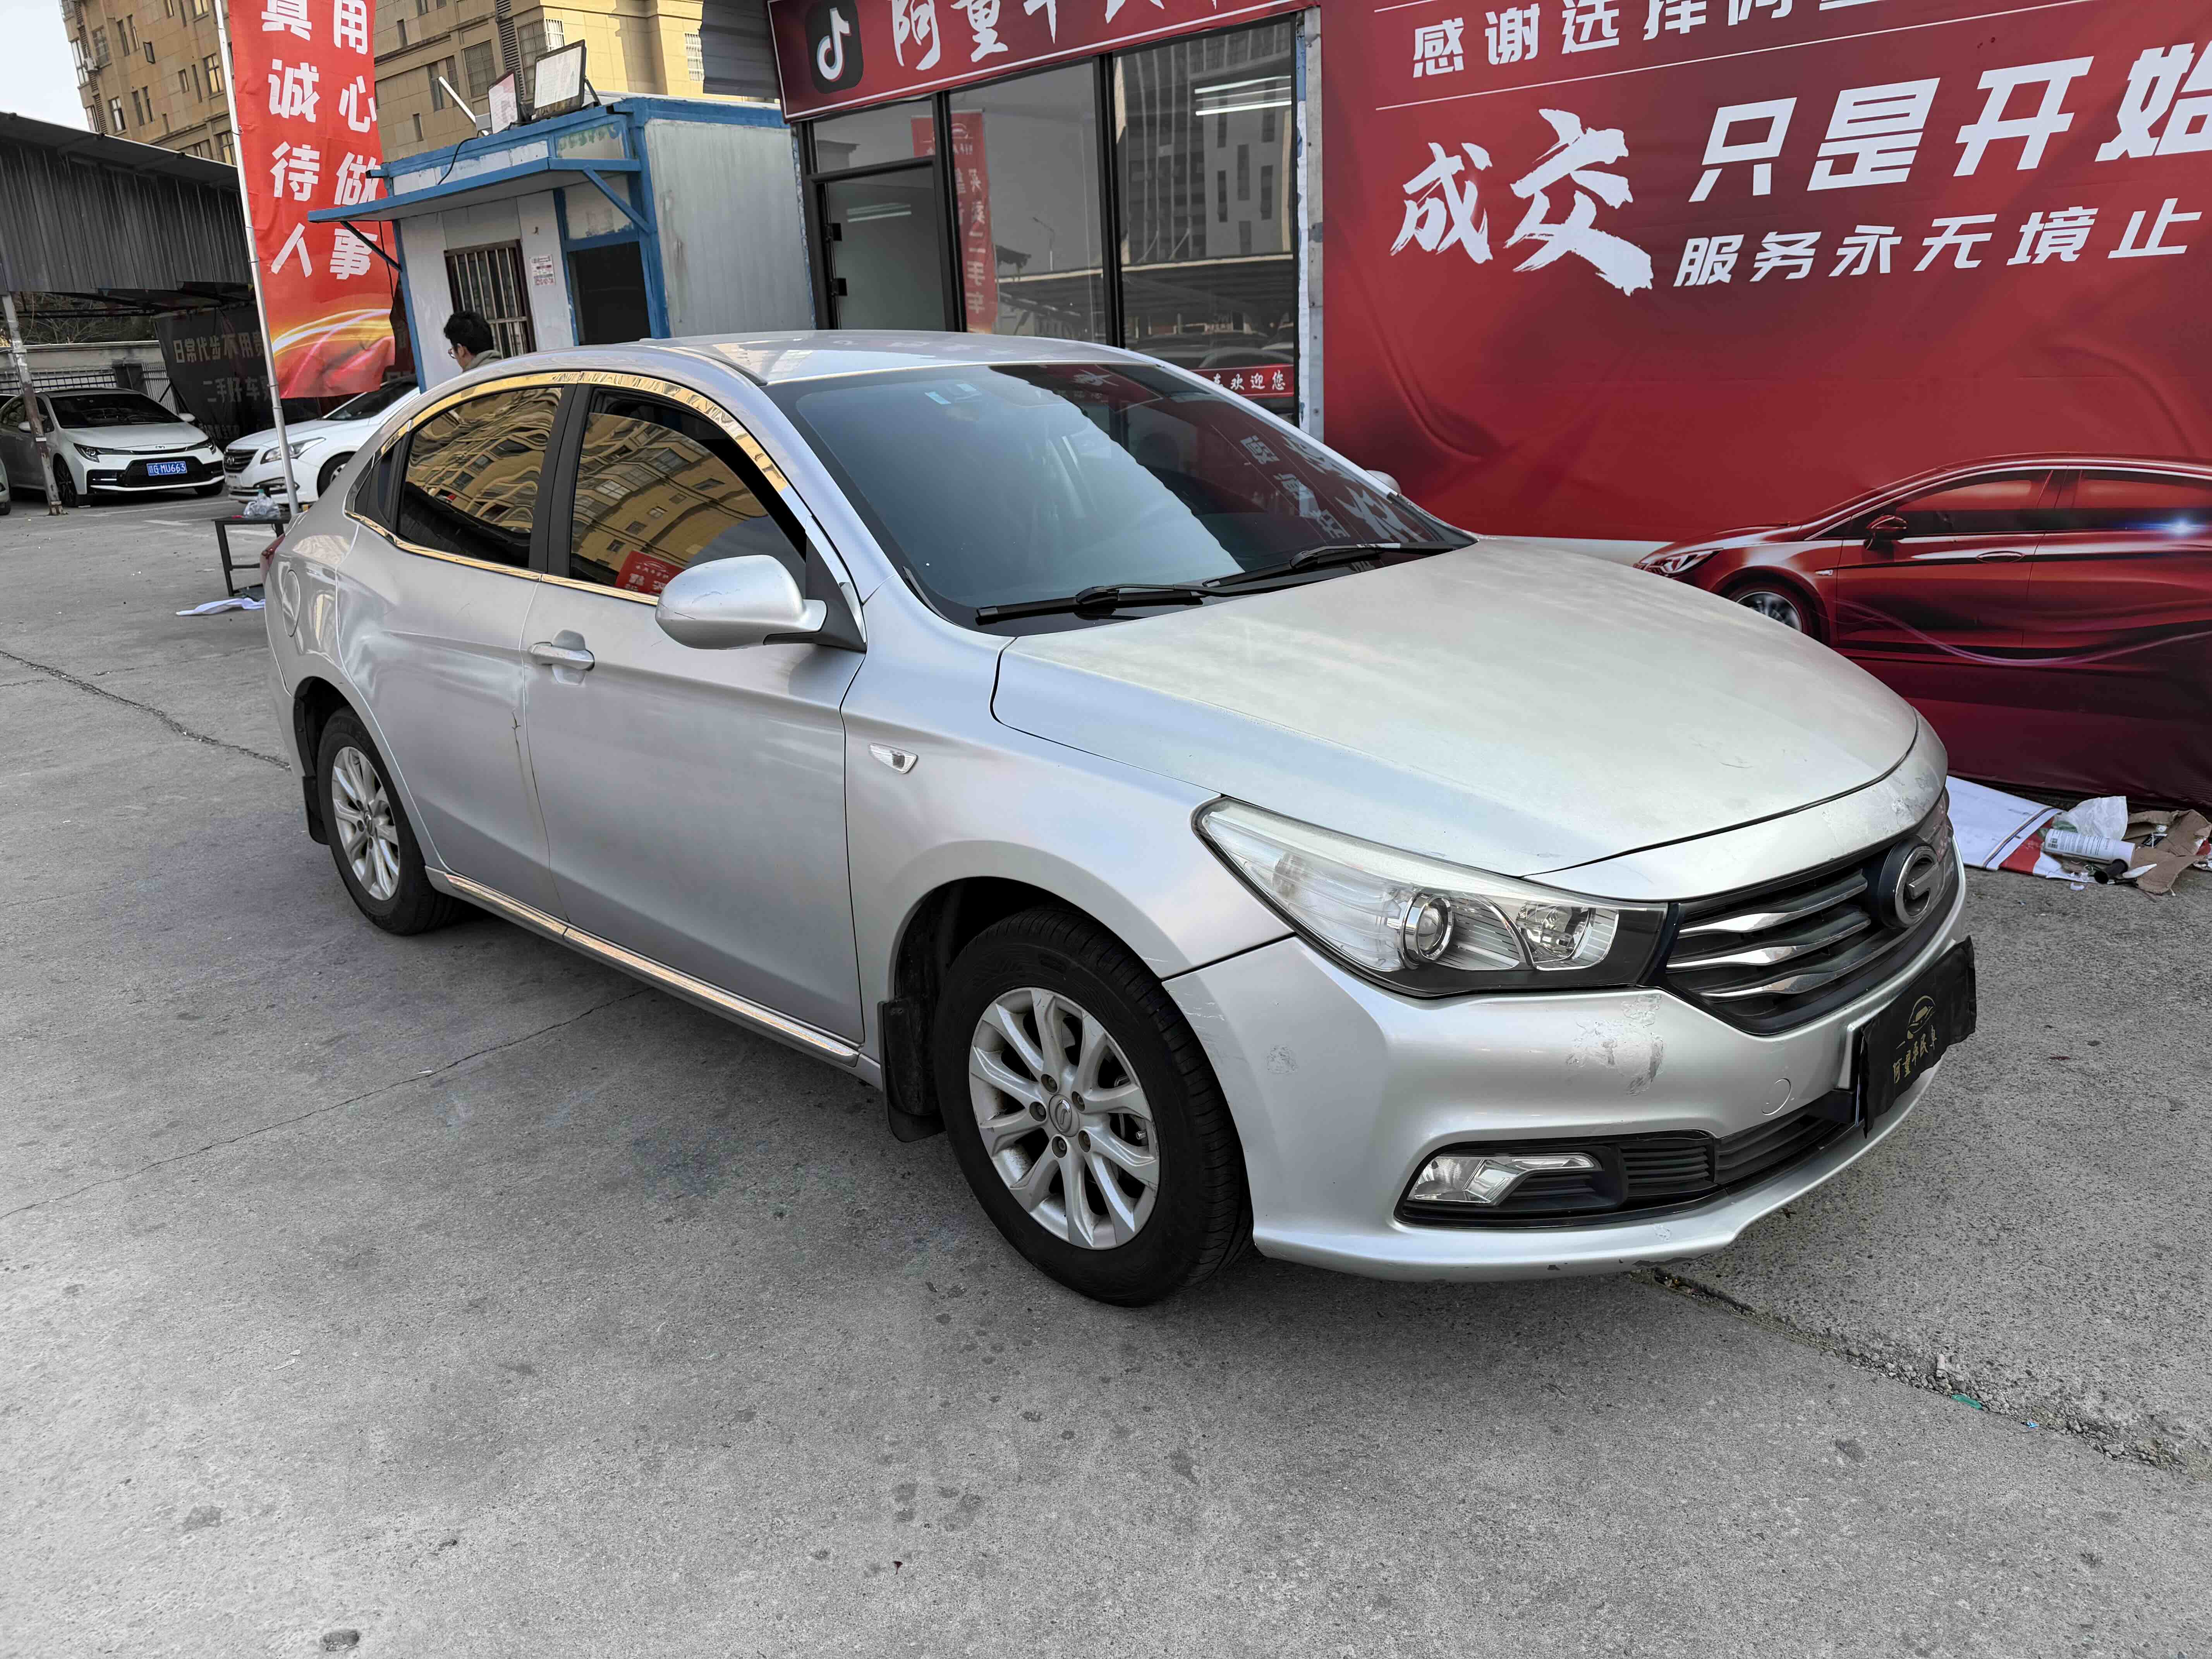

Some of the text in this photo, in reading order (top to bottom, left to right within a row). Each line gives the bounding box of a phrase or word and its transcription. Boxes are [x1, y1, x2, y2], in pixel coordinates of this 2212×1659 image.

[261, 0, 320, 278] 真诚待人
[330, 0, 381, 280] 用心做事
[1413, 0, 1887, 77] 感谢选择
[1390, 42, 2212, 296] 成交 只是开始
[1673, 198, 2202, 287] 服务永无境止
